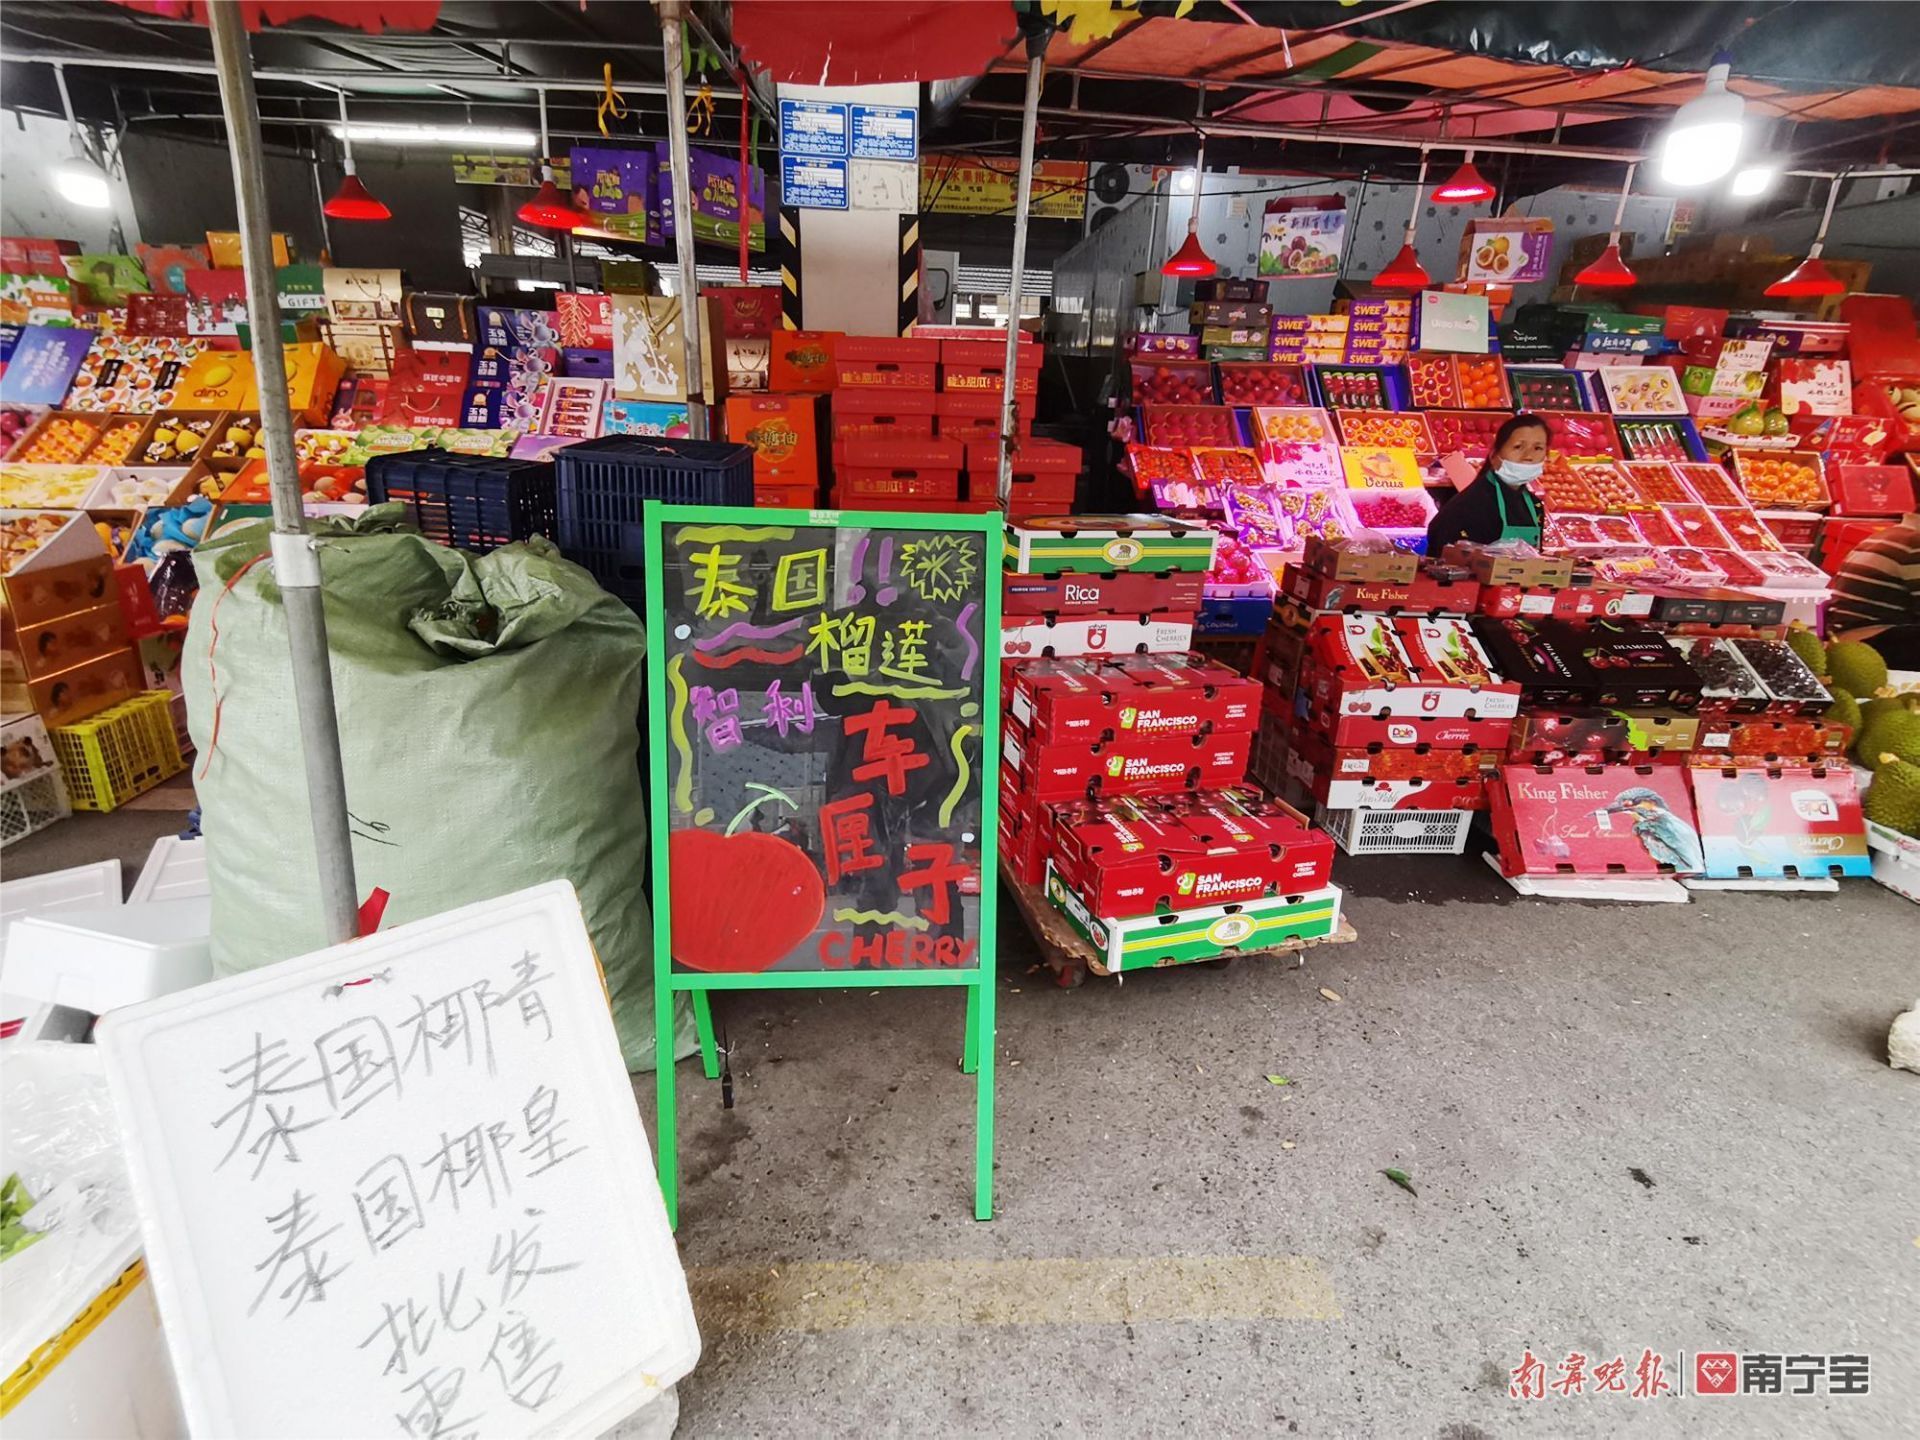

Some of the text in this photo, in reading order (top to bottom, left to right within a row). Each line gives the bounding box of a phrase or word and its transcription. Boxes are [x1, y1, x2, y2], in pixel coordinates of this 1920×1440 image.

[288, 298, 317, 307] GIFT
[193, 387, 228, 398] dino
[1364, 477, 1404, 488] Venus
[1065, 584, 1100, 601] Rica
[1355, 588, 1409, 602] King Fisher
[1156, 634, 1187, 643] CHERRIES
[805, 611, 943, 686] 榴莲
[1544, 642, 1572, 678] DIAMOND
[689, 679, 815, 753] 智利
[1137, 710, 1161, 719] SAN
[1137, 716, 1198, 728] FRANCISCO
[1392, 728, 1414, 737] Dole
[1435, 730, 1470, 741] Cherries
[1125, 758, 1148, 767] SAN
[1124, 764, 1185, 776] FRANCISCO
[1518, 783, 1608, 803] King Fisher
[1196, 877, 1262, 893] FRANCISCO
[1197, 873, 1222, 884] SAN
[818, 931, 977, 968] CHERRY
[211, 950, 556, 1181] 泰国椰青
[247, 1085, 590, 1320] 泰国椰皇
[357, 1207, 585, 1376] 批发
